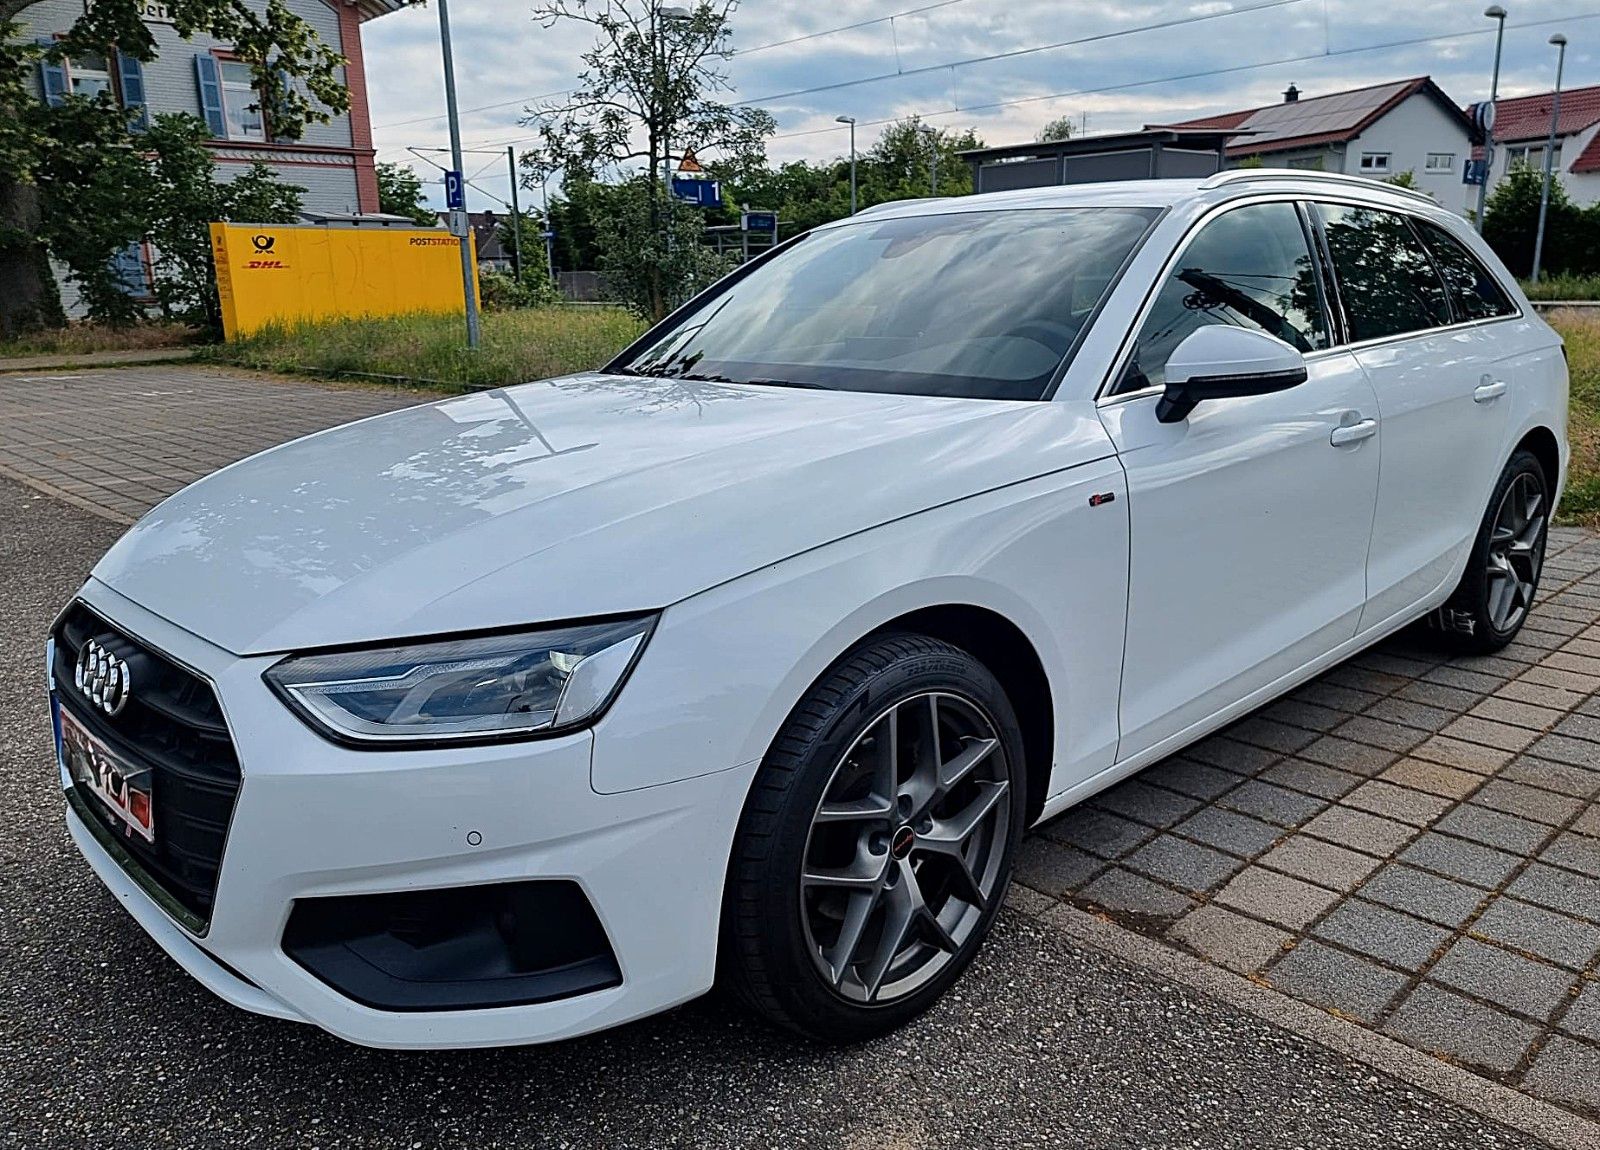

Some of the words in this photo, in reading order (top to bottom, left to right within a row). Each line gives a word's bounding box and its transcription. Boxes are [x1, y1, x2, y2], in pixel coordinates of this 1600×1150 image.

[1466, 161, 1474, 179] 2
[448, 176, 457, 204] P
[711, 181, 720, 201] 1
[409, 237, 460, 247] POSTSTATIO
[247, 260, 284, 269] DHL
